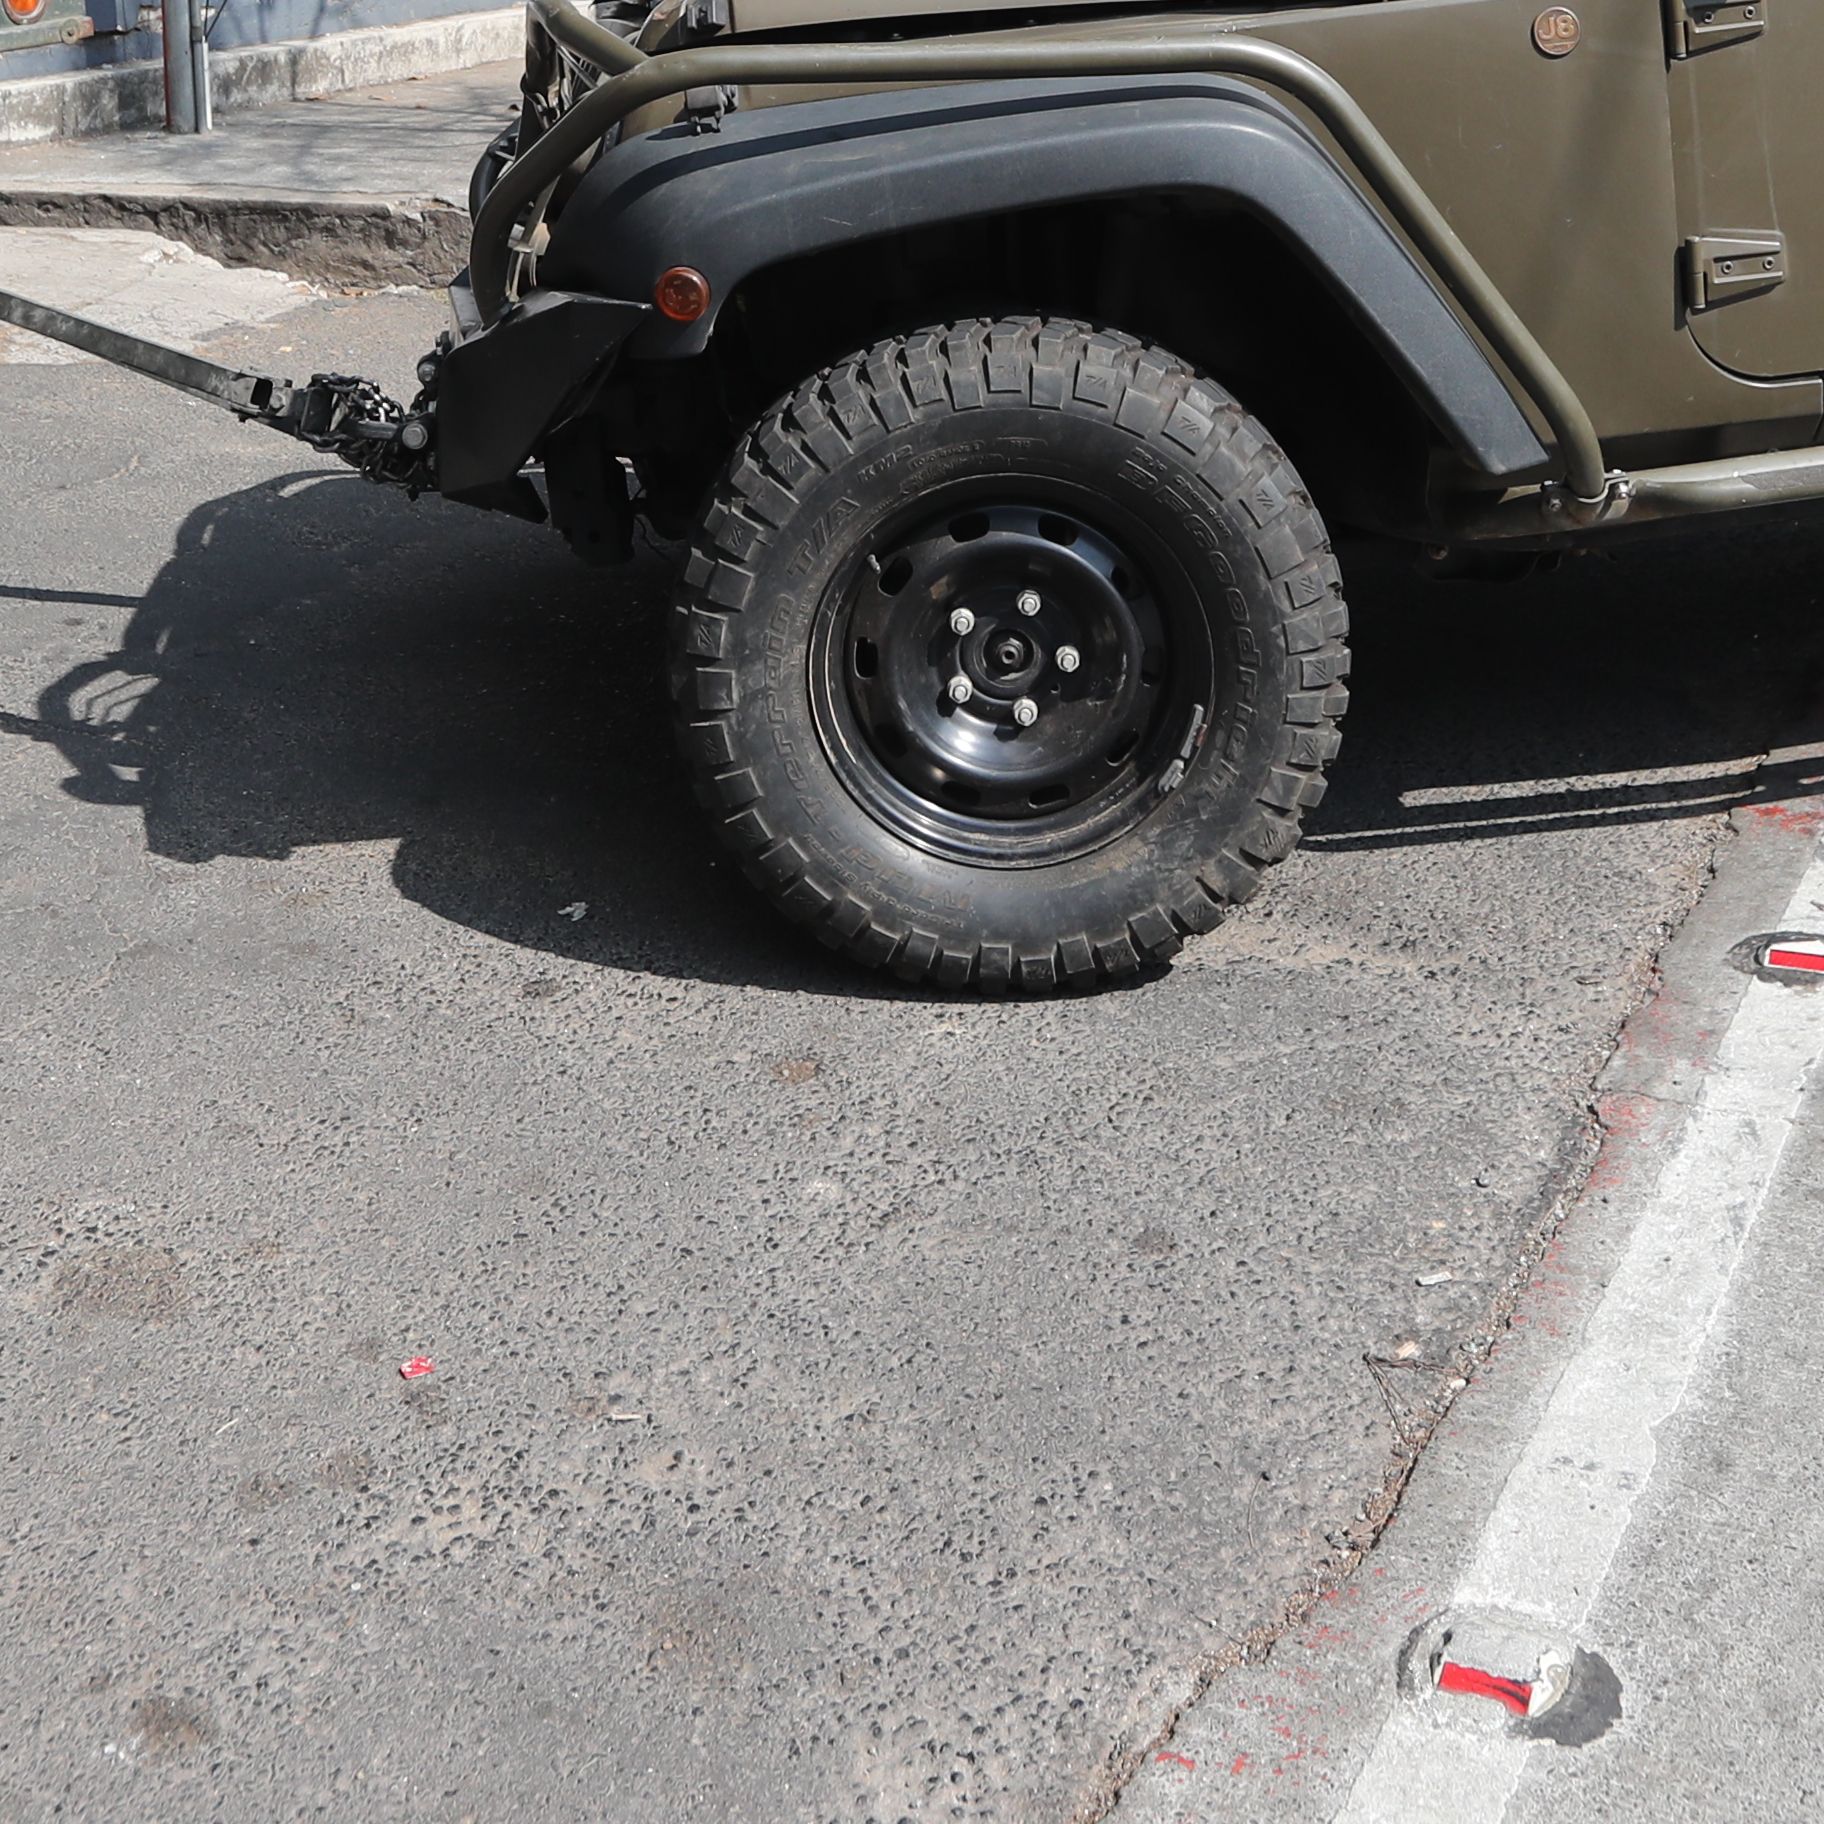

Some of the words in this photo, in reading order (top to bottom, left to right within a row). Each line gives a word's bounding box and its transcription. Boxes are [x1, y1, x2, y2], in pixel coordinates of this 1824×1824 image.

[1538, 14, 1575, 41] J8
[786, 496, 861, 577] T/A
[1173, 474, 1232, 537] Champion
